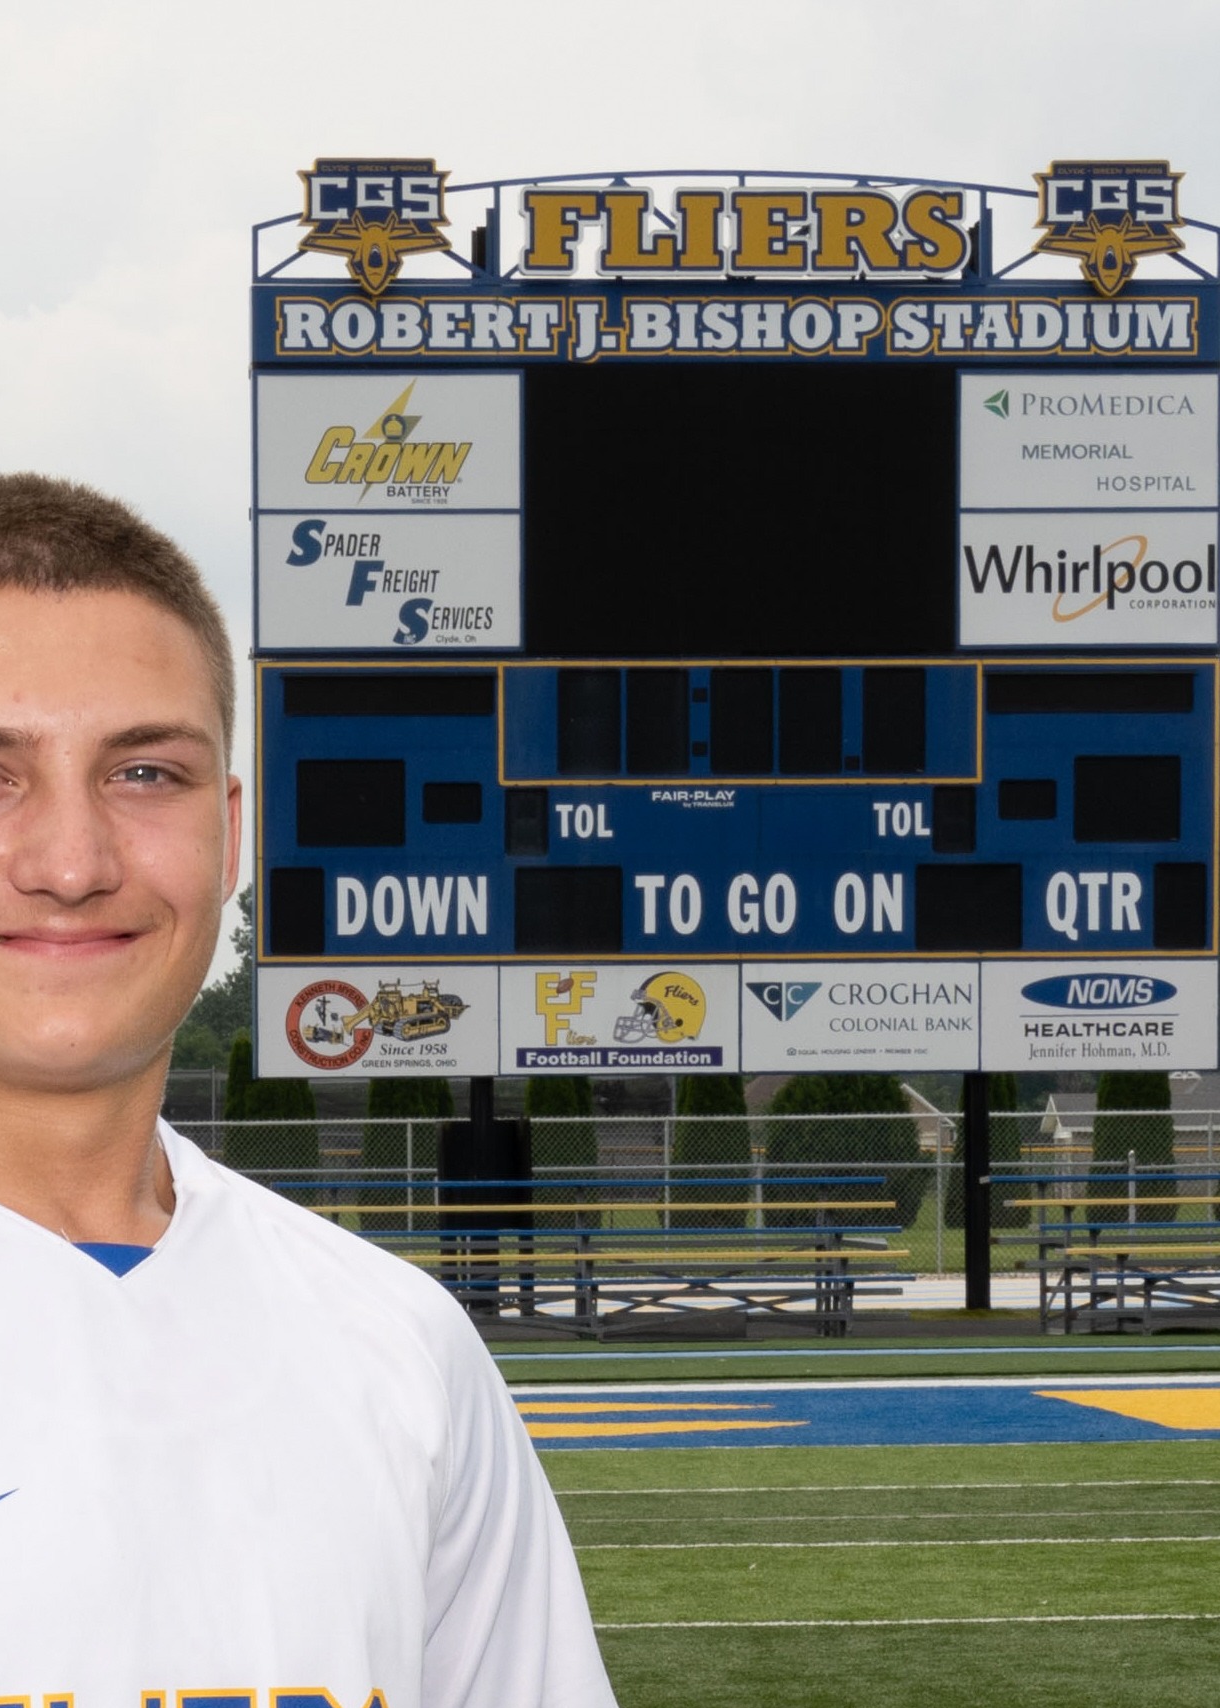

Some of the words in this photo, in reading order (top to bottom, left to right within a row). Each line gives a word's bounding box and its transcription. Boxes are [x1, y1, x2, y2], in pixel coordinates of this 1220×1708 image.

[311, 177, 439, 219] CGS
[1047, 180, 1173, 221] CGS
[521, 187, 970, 276] FLIERS
[282, 303, 558, 349] ROBERT
[575, 303, 618, 359] J.
[629, 303, 881, 349] BISHOP
[892, 303, 1191, 349] STADIUM
[305, 426, 473, 484] CROWN
[1022, 444, 1133, 460] MEMORIAL
[386, 486, 450, 497] BATTERY
[1096, 476, 1196, 492] HOSPITAL
[286, 519, 381, 567] SPADER
[346, 560, 440, 606] FREIGHT
[963, 544, 1215, 610] Whirlpool
[1130, 599, 1216, 609] CORPORATION
[393, 598, 493, 645] SERVICES
[556, 804, 613, 838] TOL
[873, 802, 930, 836] TOL
[336, 876, 488, 936] DOWN
[635, 874, 702, 935] TO
[728, 873, 797, 934] GO
[834, 873, 903, 934] ON
[1046, 871, 1142, 941] QTR
[295, 982, 336, 1007] KENNETH
[664, 985, 699, 1006] Fliers
[828, 983, 972, 1005] CROGHAN
[1067, 978, 1153, 1004] NOMS
[830, 1017, 918, 1032] COLONIAL
[925, 1017, 973, 1031] BANK
[1024, 1022, 1174, 1037] HEALTHCARE
[362, 1060, 392, 1068] GREEN
[394, 1059, 433, 1068] SPRINGS,
[435, 1059, 458, 1067] OHIO
[380, 1043, 415, 1056] Since
[420, 1043, 448, 1055] 1958
[526, 1051, 601, 1065] Football
[608, 1051, 711, 1065] Foundation
[1029, 1043, 1077, 1060] Jennifer
[1081, 1043, 1136, 1058] Hohman,
[1141, 1042, 1171, 1057] M.D.
